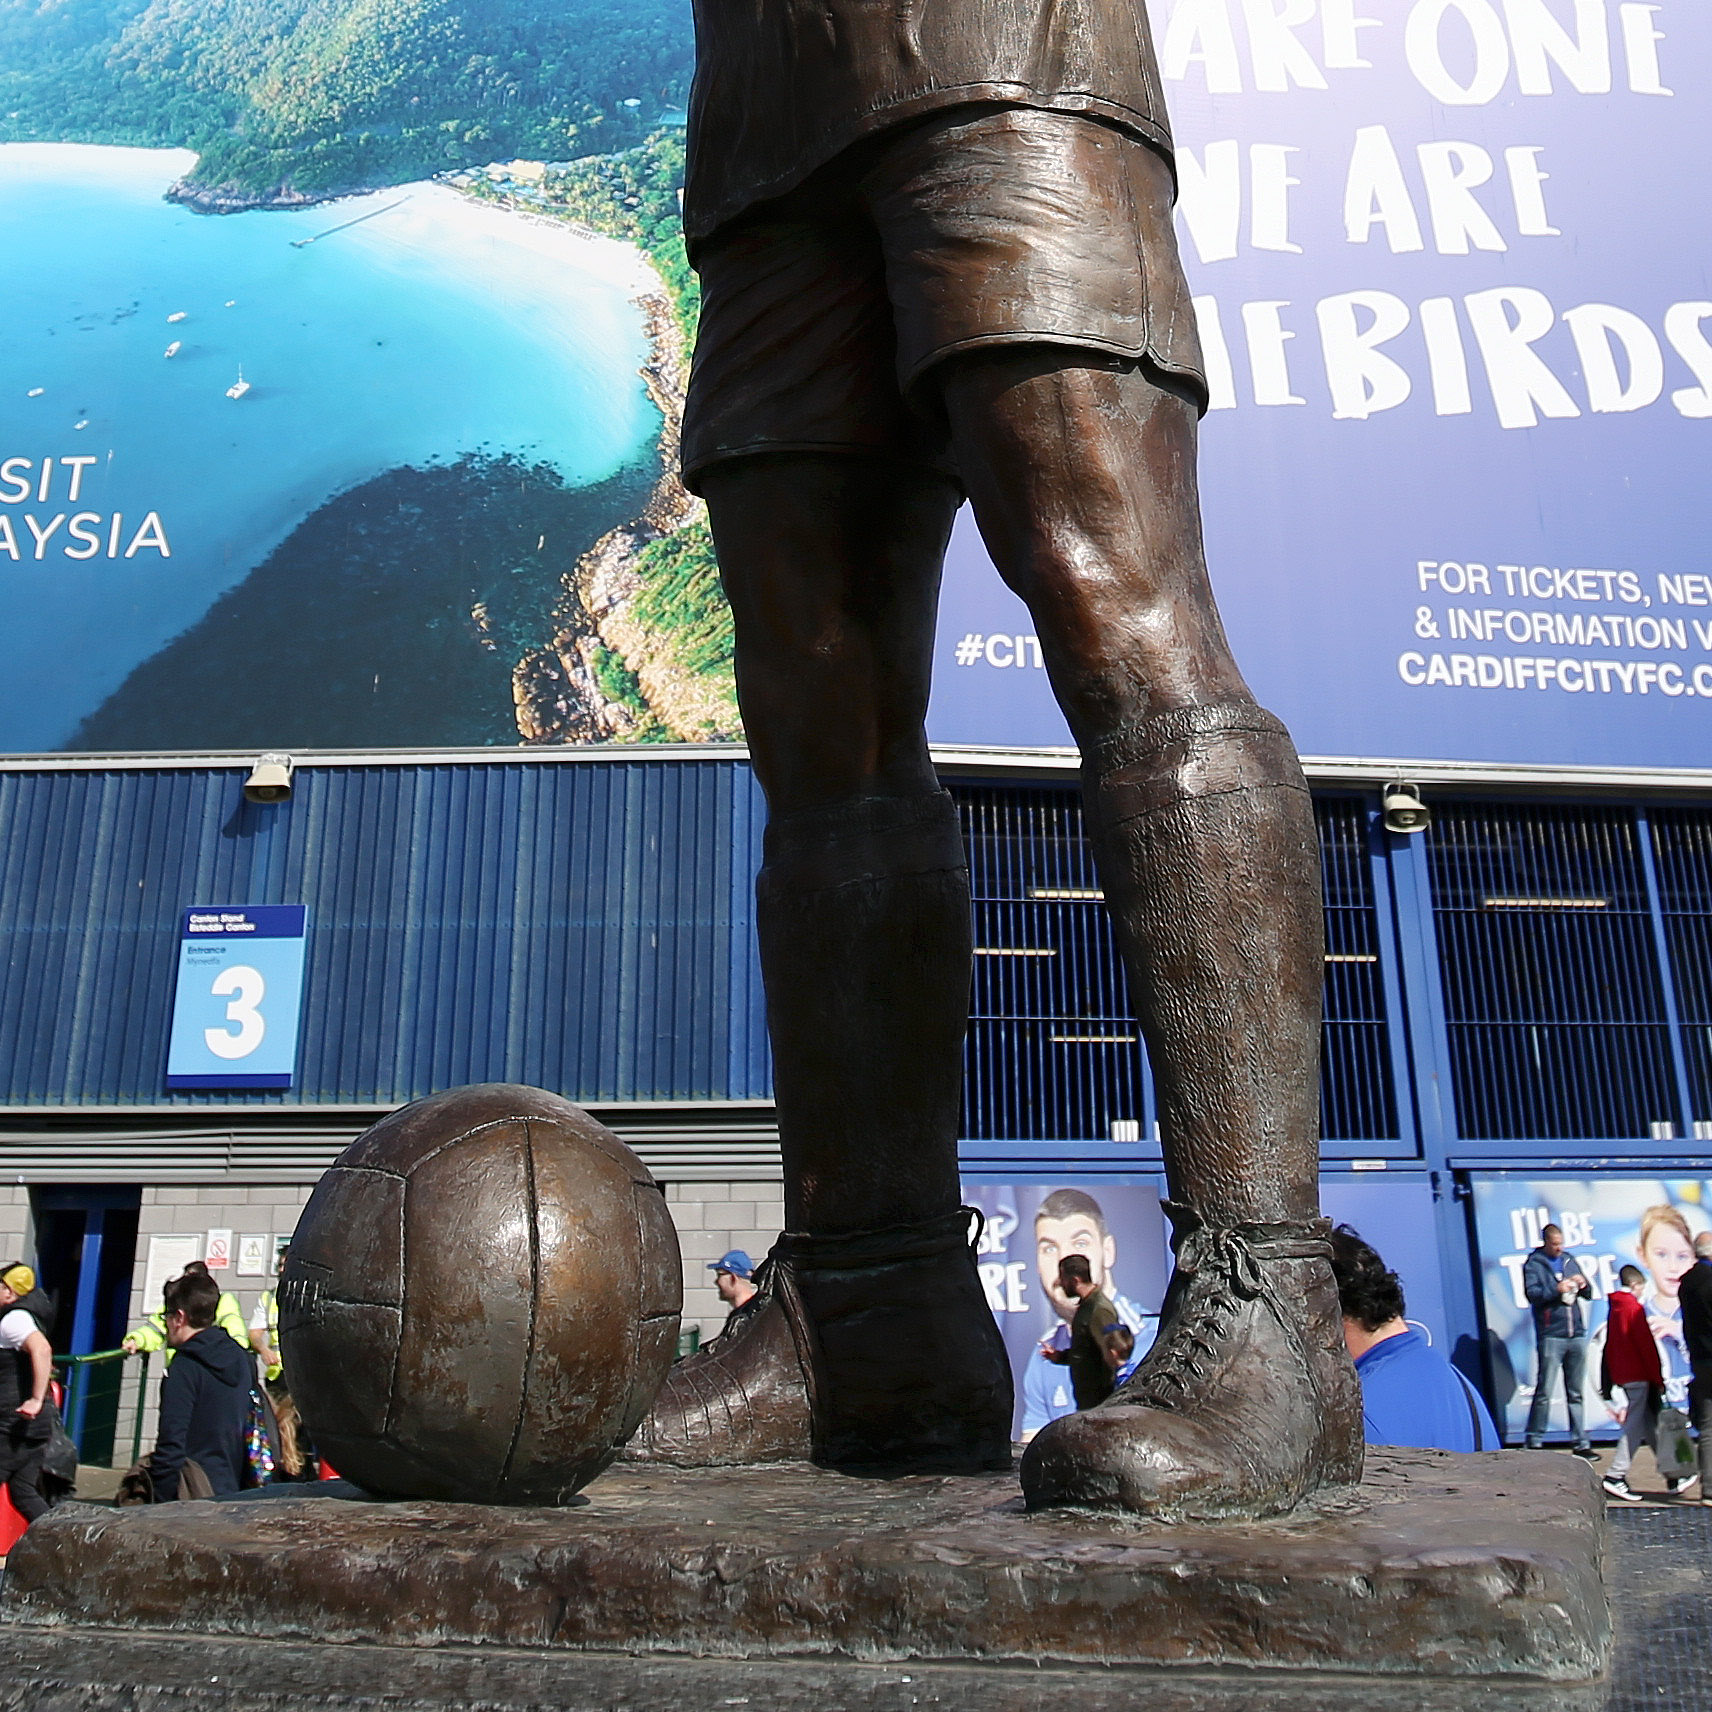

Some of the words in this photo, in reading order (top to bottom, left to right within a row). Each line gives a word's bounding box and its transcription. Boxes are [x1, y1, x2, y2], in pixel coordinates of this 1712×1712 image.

[1343, 124, 1561, 255] ARE
[1418, 560, 1491, 597] FOR
[1496, 565, 1651, 608] TICKETS,
[1414, 607, 1441, 640] &
[1448, 608, 1687, 650] INFORMATION
[204, 964, 267, 1061] 3
[1559, 1211, 1598, 1249] BE
